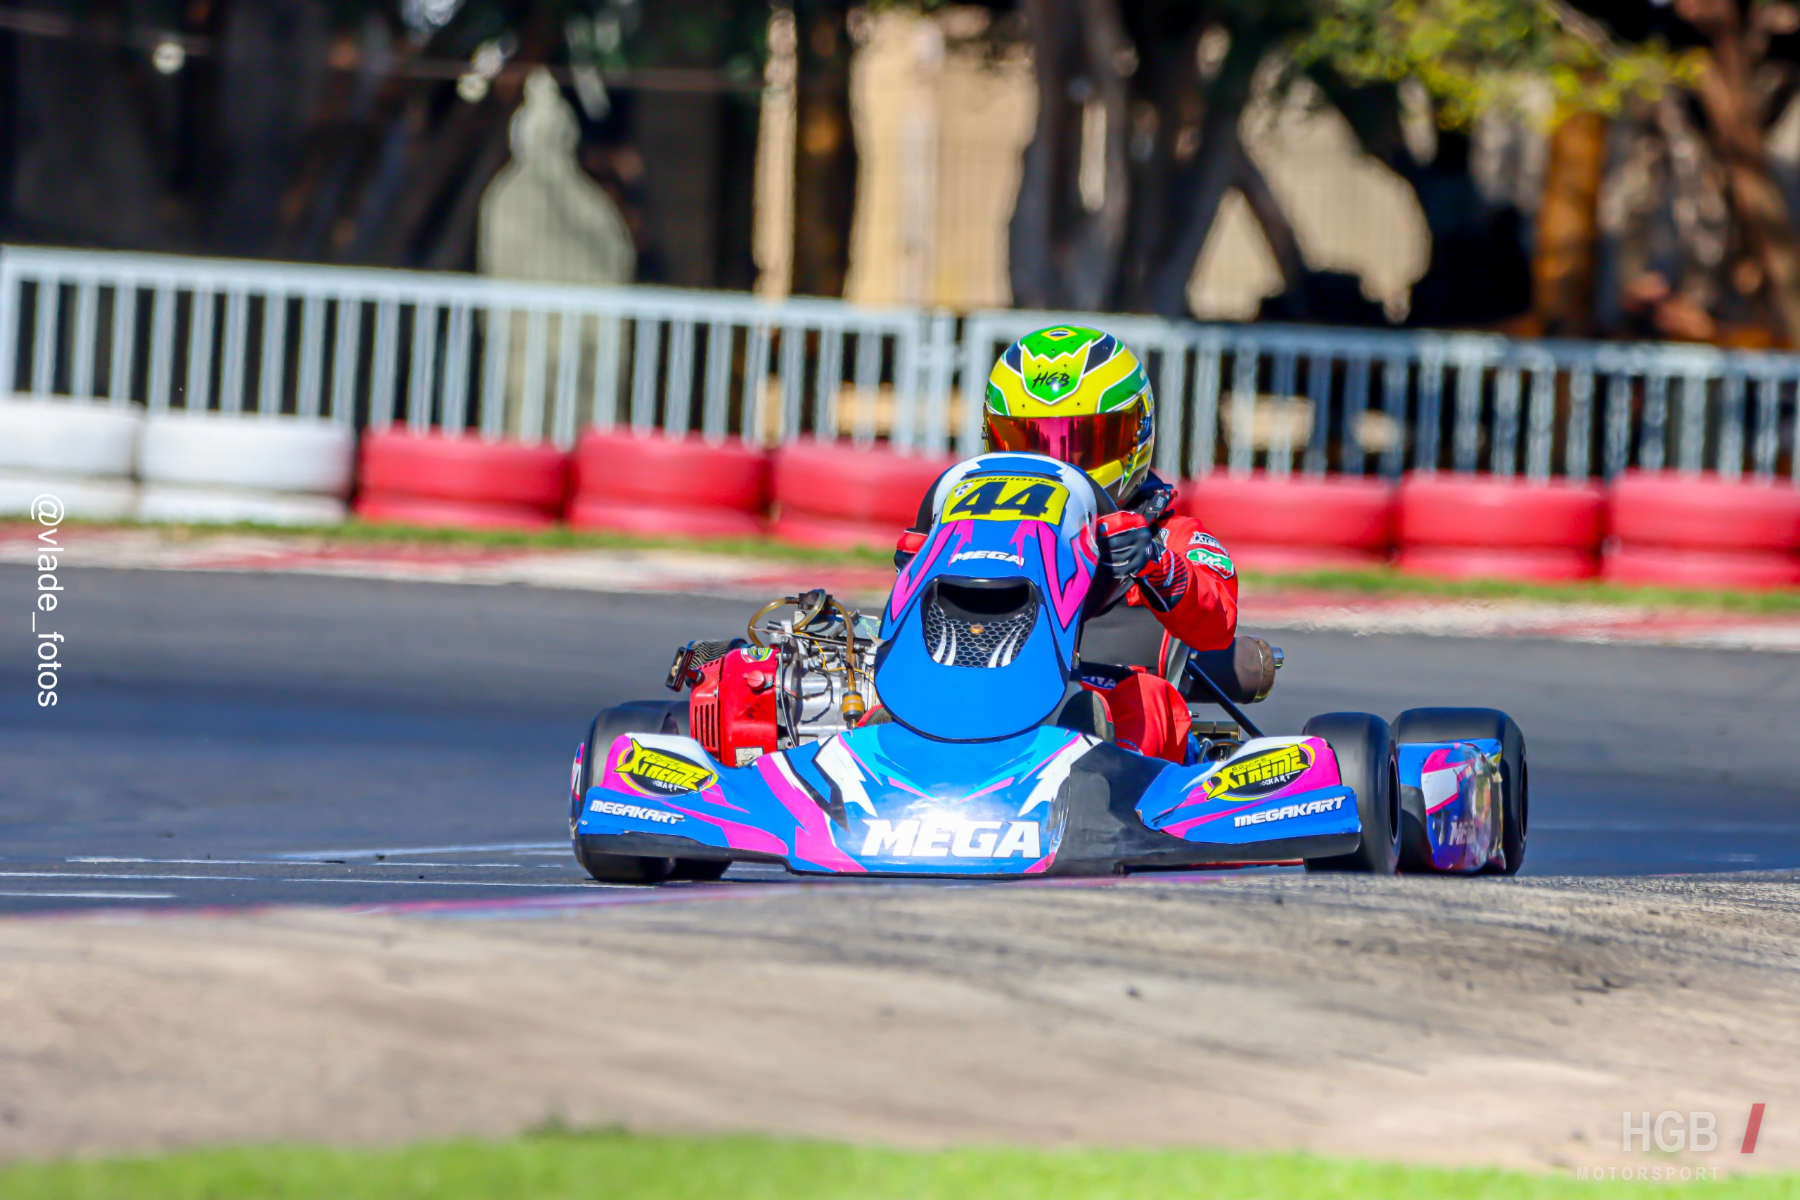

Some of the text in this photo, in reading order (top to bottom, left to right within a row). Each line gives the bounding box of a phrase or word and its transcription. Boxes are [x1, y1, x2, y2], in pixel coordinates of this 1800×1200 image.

[1031, 371, 1070, 390] HGB
[949, 481, 1057, 517] 44
[950, 550, 1025, 567] MEGA
[1231, 757, 1268, 772] EQUIPE
[1266, 770, 1300, 786] KART
[590, 799, 686, 825] MEGAKART
[1234, 795, 1347, 828] MEGAKART
[860, 817, 1042, 859] MEGA
